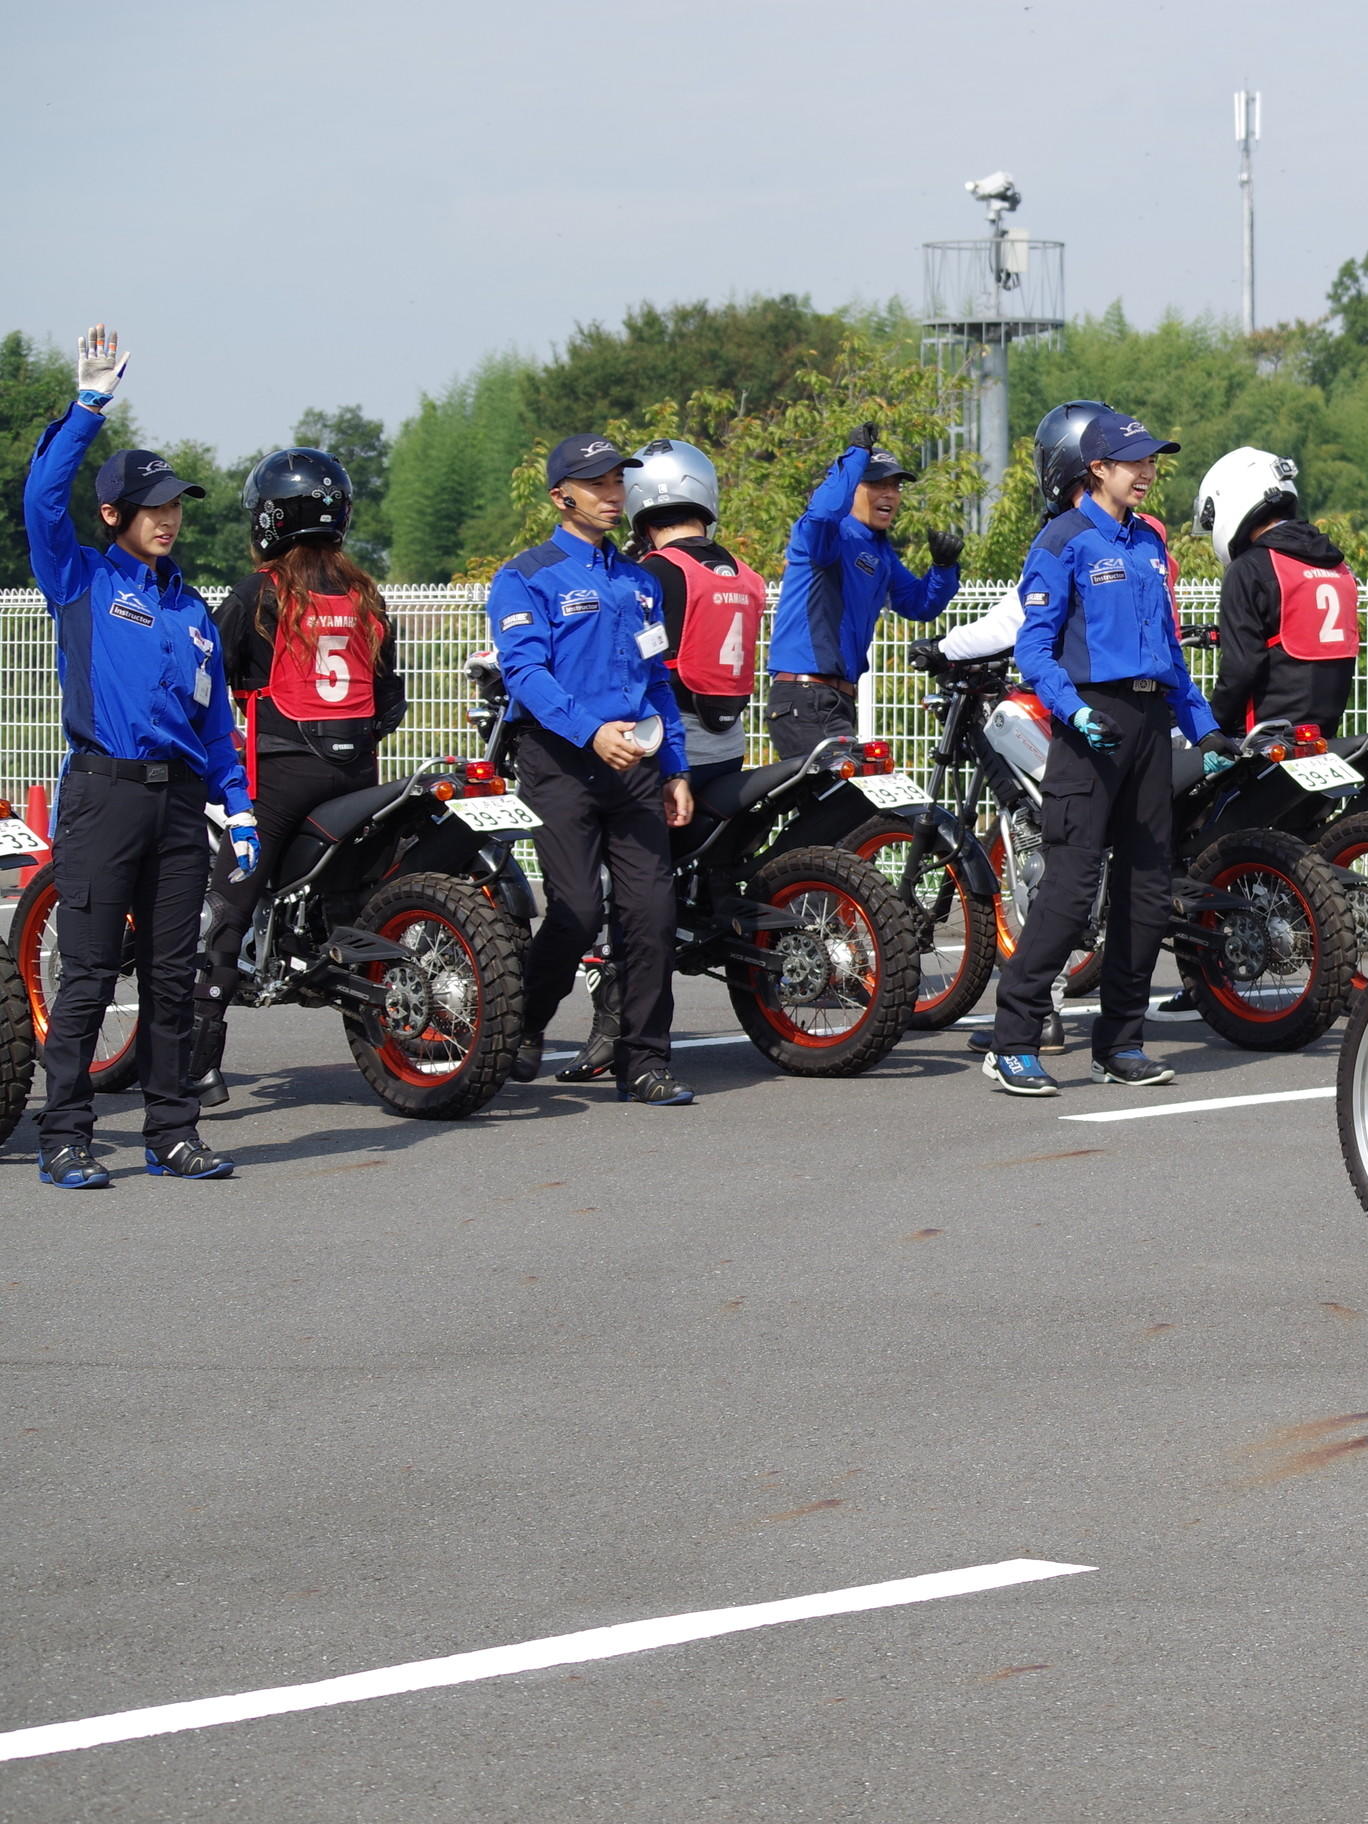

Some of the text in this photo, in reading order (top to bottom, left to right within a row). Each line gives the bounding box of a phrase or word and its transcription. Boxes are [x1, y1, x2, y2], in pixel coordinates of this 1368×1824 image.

[113, 606, 152, 625] Instructor
[1315, 583, 1345, 643] 2
[718, 611, 745, 677] 4
[315, 634, 351, 703] 5
[1297, 764, 1355, 787] 39-41
[867, 785, 925, 804] 39-39
[464, 808, 533, 827] 39-38
